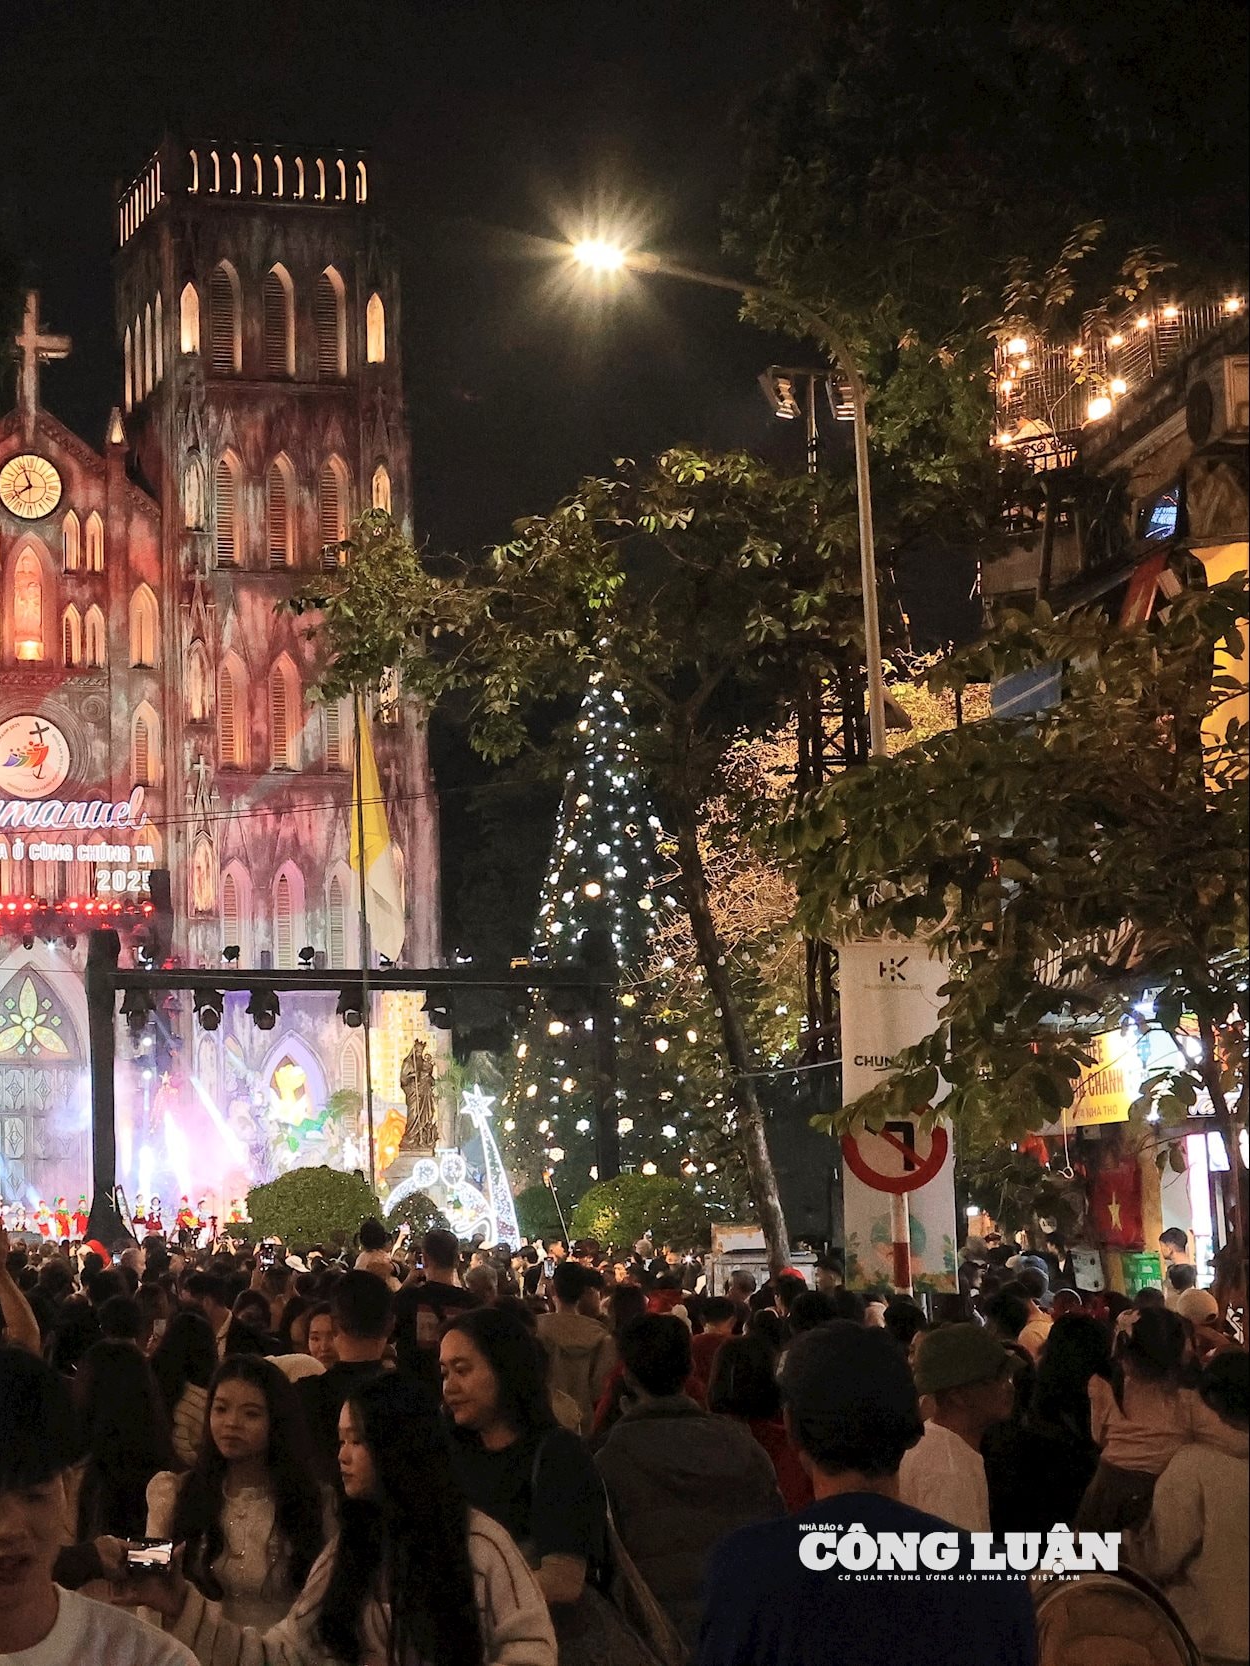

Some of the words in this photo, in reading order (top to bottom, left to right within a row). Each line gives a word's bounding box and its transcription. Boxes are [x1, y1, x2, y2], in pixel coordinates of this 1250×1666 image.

[12, 837, 25, 860] Ở
[76, 841, 131, 862] CHÚNG
[134, 845, 155, 862] TA
[854, 1055, 894, 1067] CHUN
